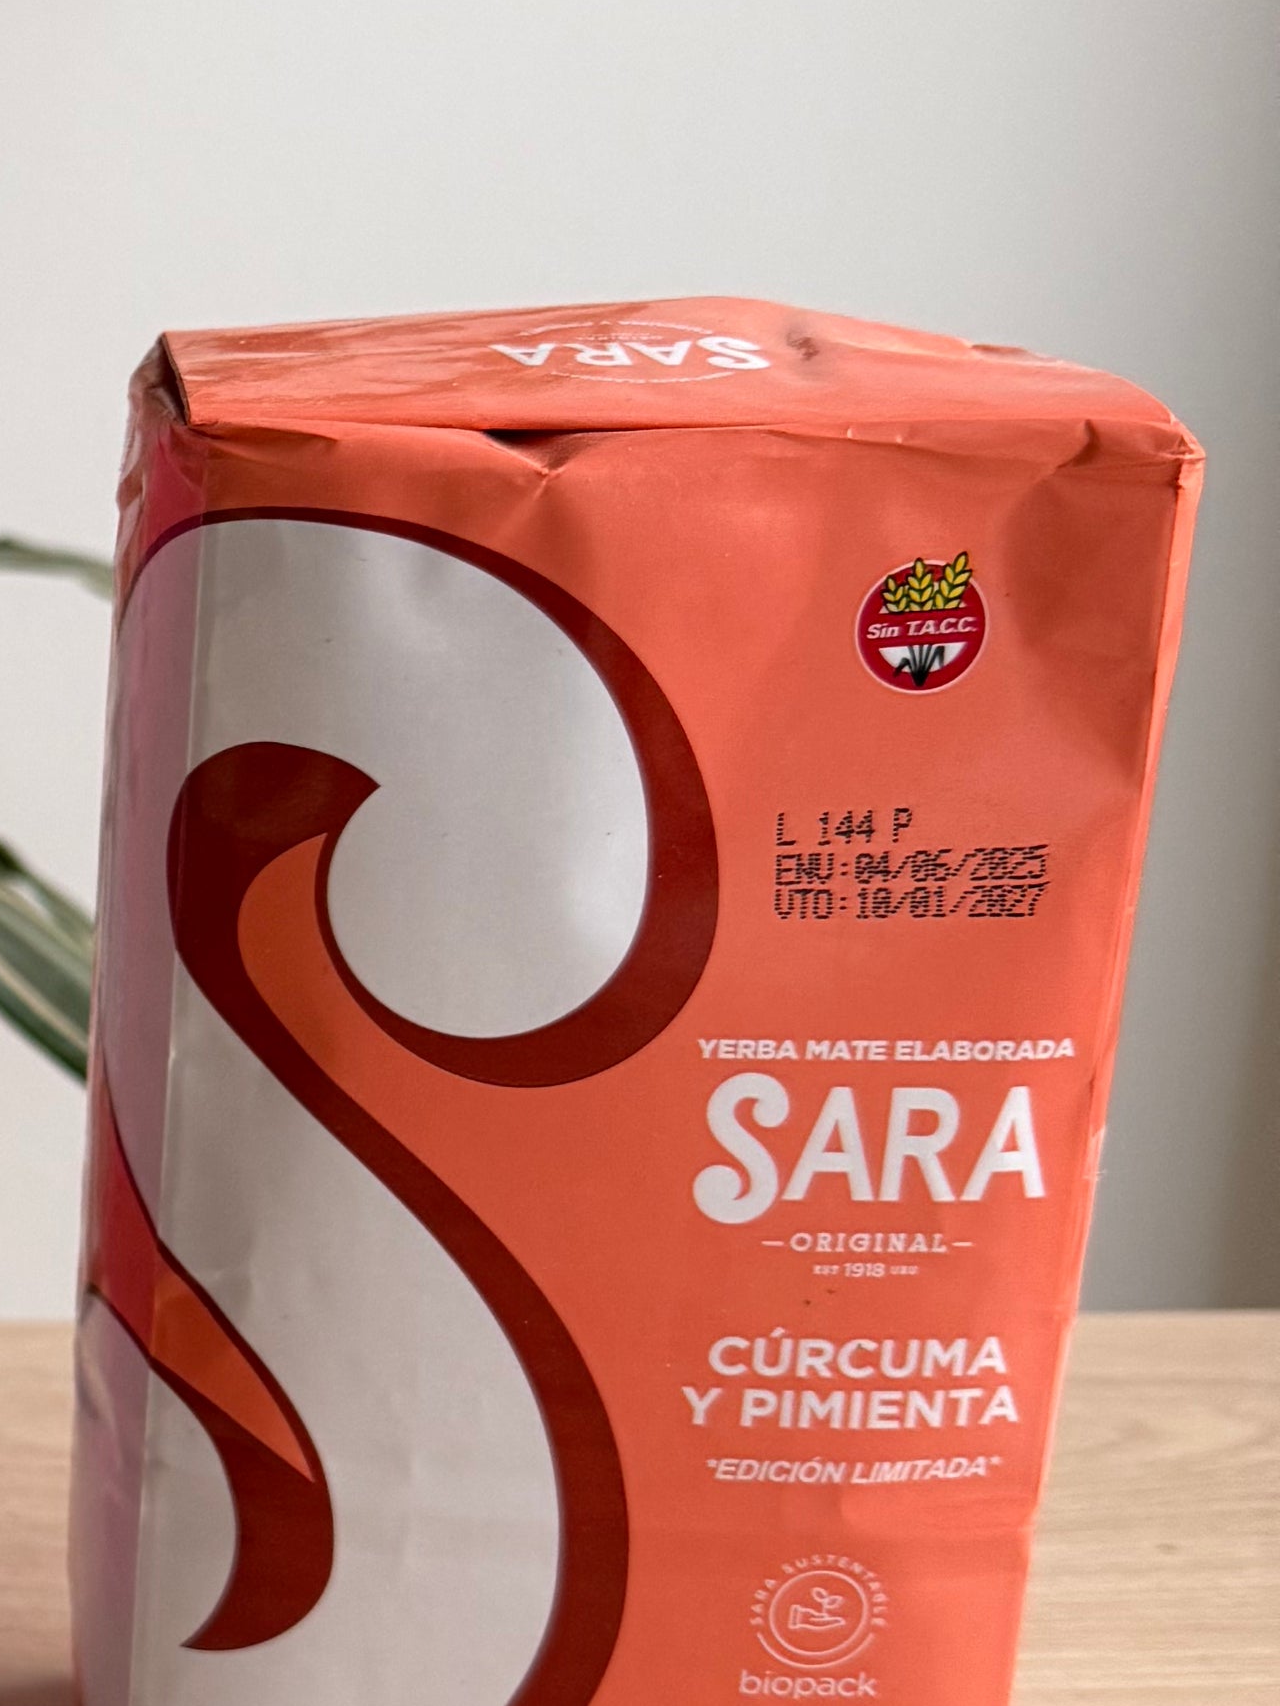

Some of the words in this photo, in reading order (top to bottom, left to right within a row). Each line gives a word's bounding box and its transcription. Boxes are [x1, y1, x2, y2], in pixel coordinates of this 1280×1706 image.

[488, 336, 771, 370] SARA
[866, 623, 899, 639] Sin
[907, 617, 977, 636] T.A.C.C.
[776, 812, 796, 845] L
[818, 809, 875, 845] 144
[892, 807, 912, 843] P
[698, 1038, 797, 1061] YERBA
[805, 1039, 887, 1061] MATE
[894, 1037, 1075, 1062] ELABORADA
[693, 1071, 1046, 1224] SARA
[790, 1232, 947, 1253] ORIGINAL
[844, 1263, 884, 1277] 1918
[708, 1326, 1007, 1378] CÚRCUMA
[682, 1386, 722, 1426] Y
[742, 1385, 1019, 1430] PIMIENTA
[739, 1669, 877, 1700] biopack
